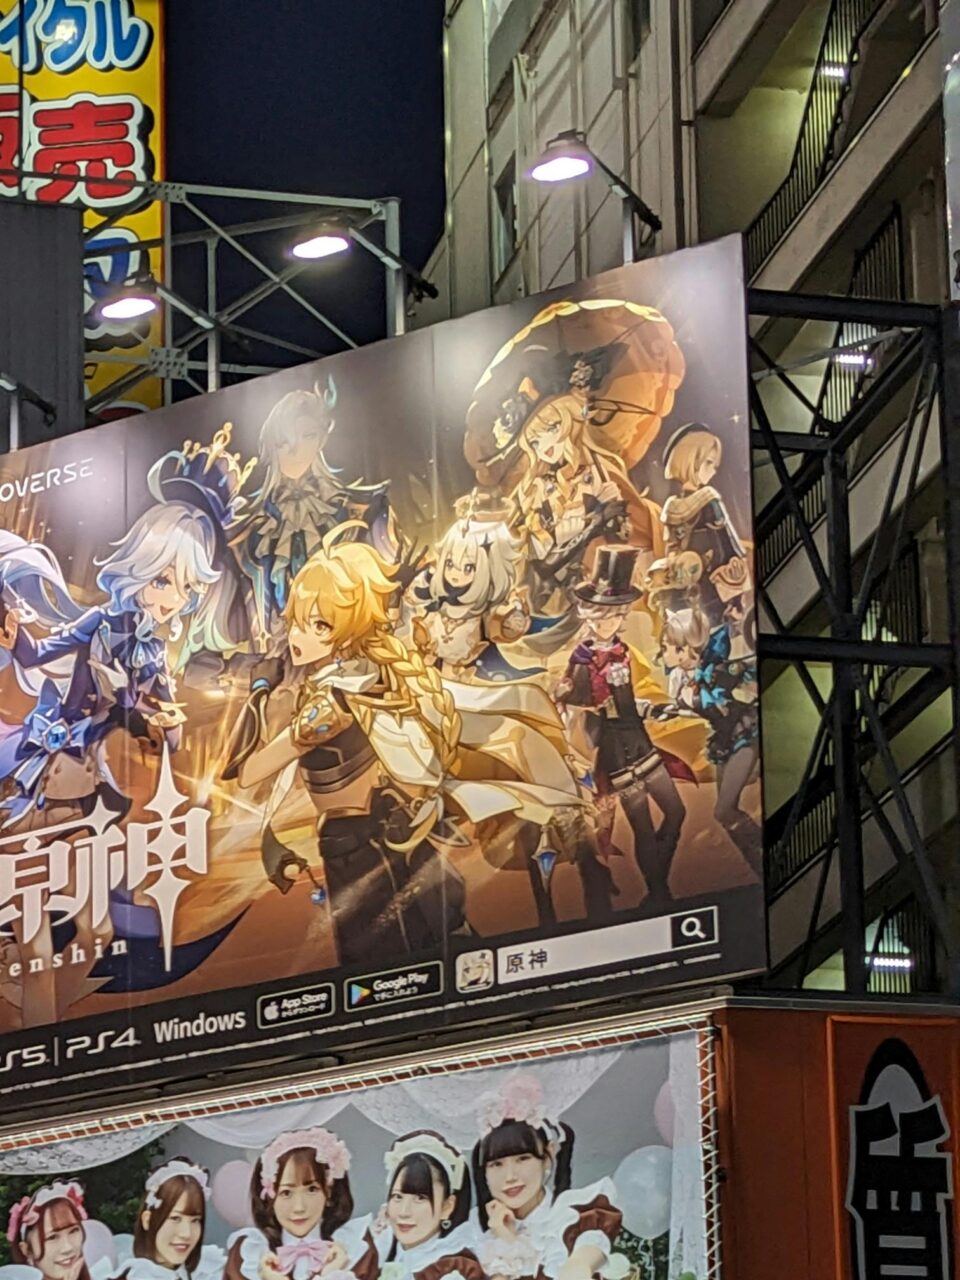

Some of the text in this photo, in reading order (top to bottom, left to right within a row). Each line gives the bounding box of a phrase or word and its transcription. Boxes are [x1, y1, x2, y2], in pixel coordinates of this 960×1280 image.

[505, 948, 548, 974] 原神
[373, 977, 406, 992] Google
[66, 1027, 140, 1059] PS4
[153, 1010, 246, 1044] Windows
